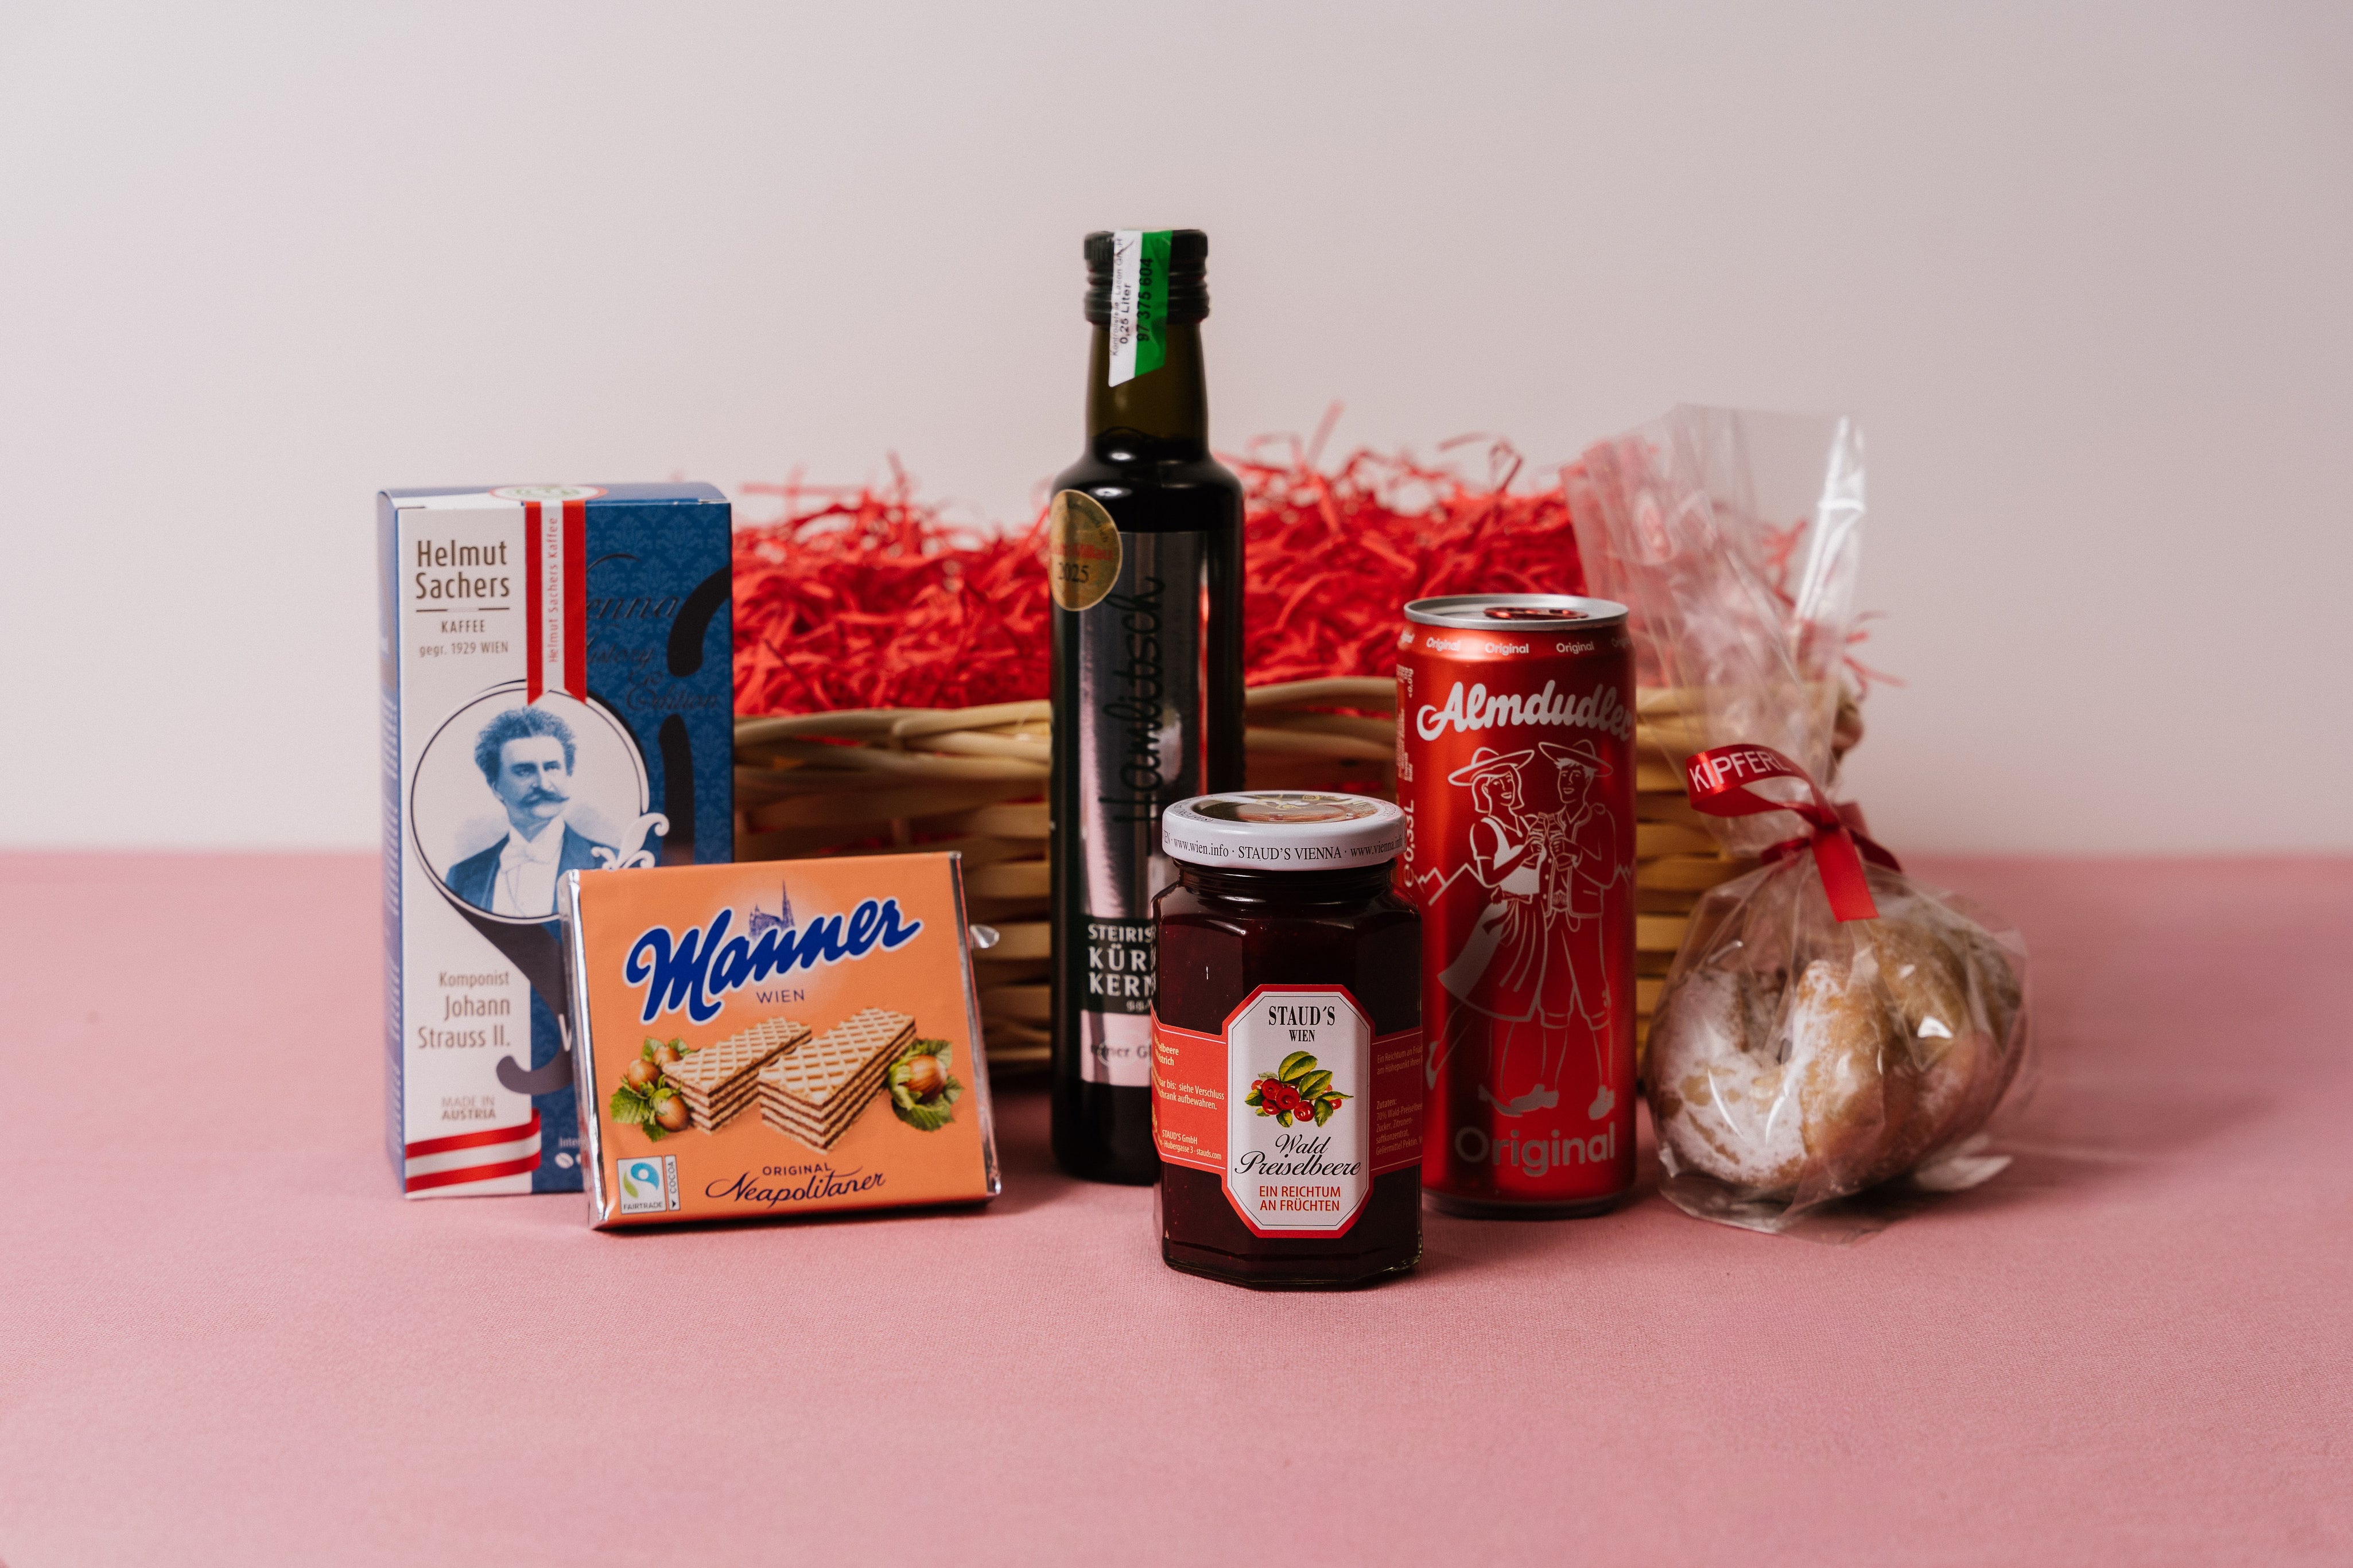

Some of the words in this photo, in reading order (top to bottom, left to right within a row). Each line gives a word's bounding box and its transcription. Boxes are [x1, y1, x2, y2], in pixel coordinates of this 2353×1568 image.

[1139, 258, 1153, 286] 604
[1121, 283, 1131, 313] Liter
[1137, 292, 1152, 320] 375
[1120, 318, 1129, 344] 0,25
[1136, 324, 1150, 342] 97
[548, 518, 557, 559] Kaffee
[417, 539, 507, 568] Helmut
[416, 573, 510, 600] Sachers
[548, 565, 558, 613] Sachers
[441, 619, 486, 633] KAFFEE
[420, 643, 447, 657] gegr.
[451, 641, 476, 655] 1929
[480, 641, 508, 654] WIEN
[548, 619, 558, 663] Helmut
[1485, 642, 1529, 656] Original
[1556, 641, 1595, 655] Original
[1690, 750, 1791, 792] KIPFERL
[1174, 838, 1229, 857] www.wien.info
[1238, 846, 1291, 861] STAUD'S
[1295, 846, 1342, 860] VIENNA
[1350, 834, 1403, 857] www.vienna.info
[624, 898, 922, 1022] Manner
[1089, 944, 1151, 972] KÜR
[439, 971, 510, 988] Komponist
[756, 989, 805, 1004] WIEN
[444, 995, 510, 1021] Johann
[418, 1026, 486, 1050] Strauss
[493, 1025, 511, 1047] II.
[1288, 1029, 1315, 1042] WIEN
[1385, 1050, 1406, 1061] Reichtum
[1377, 1067, 1385, 1075] am
[1385, 1059, 1410, 1073] Höhepunkt
[1410, 1058, 1420, 1066] ihrer
[1167, 1080, 1176, 1090] bis:
[1179, 1083, 1194, 1094] siehe
[1195, 1085, 1225, 1100] Verschluss
[441, 1096, 477, 1108] MADE
[482, 1096, 495, 1107] IN
[1178, 1093, 1217, 1110] aufbewahren.
[1377, 1098, 1397, 1110] Zutaten:
[442, 1108, 496, 1121] AUSTRIA
[1377, 1111, 1387, 1122] 70%
[1393, 1117, 1414, 1129] Zitronen-
[1182, 1134, 1198, 1145] GmbH
[1275, 1134, 1331, 1155] Wald
[1376, 1141, 1402, 1155] Geliermittel
[1164, 1141, 1190, 1155] Hubergasse
[1190, 1146, 1194, 1154] 3
[1196, 1148, 1222, 1160] stauds.com
[1455, 1121, 1615, 1177] Original
[762, 1162, 832, 1176] ORIGINAL
[1234, 1150, 1361, 1176] Preiselbeere
[668, 1161, 677, 1194] COCOA
[705, 1165, 886, 1208] Neapolitaner
[1259, 1186, 1278, 1197] EIN
[1282, 1186, 1341, 1197] REICHTUM
[624, 1201, 663, 1211] FAIRTRADE
[1260, 1200, 1276, 1211] AN
[1279, 1197, 1340, 1212] FRÜCHTEN
